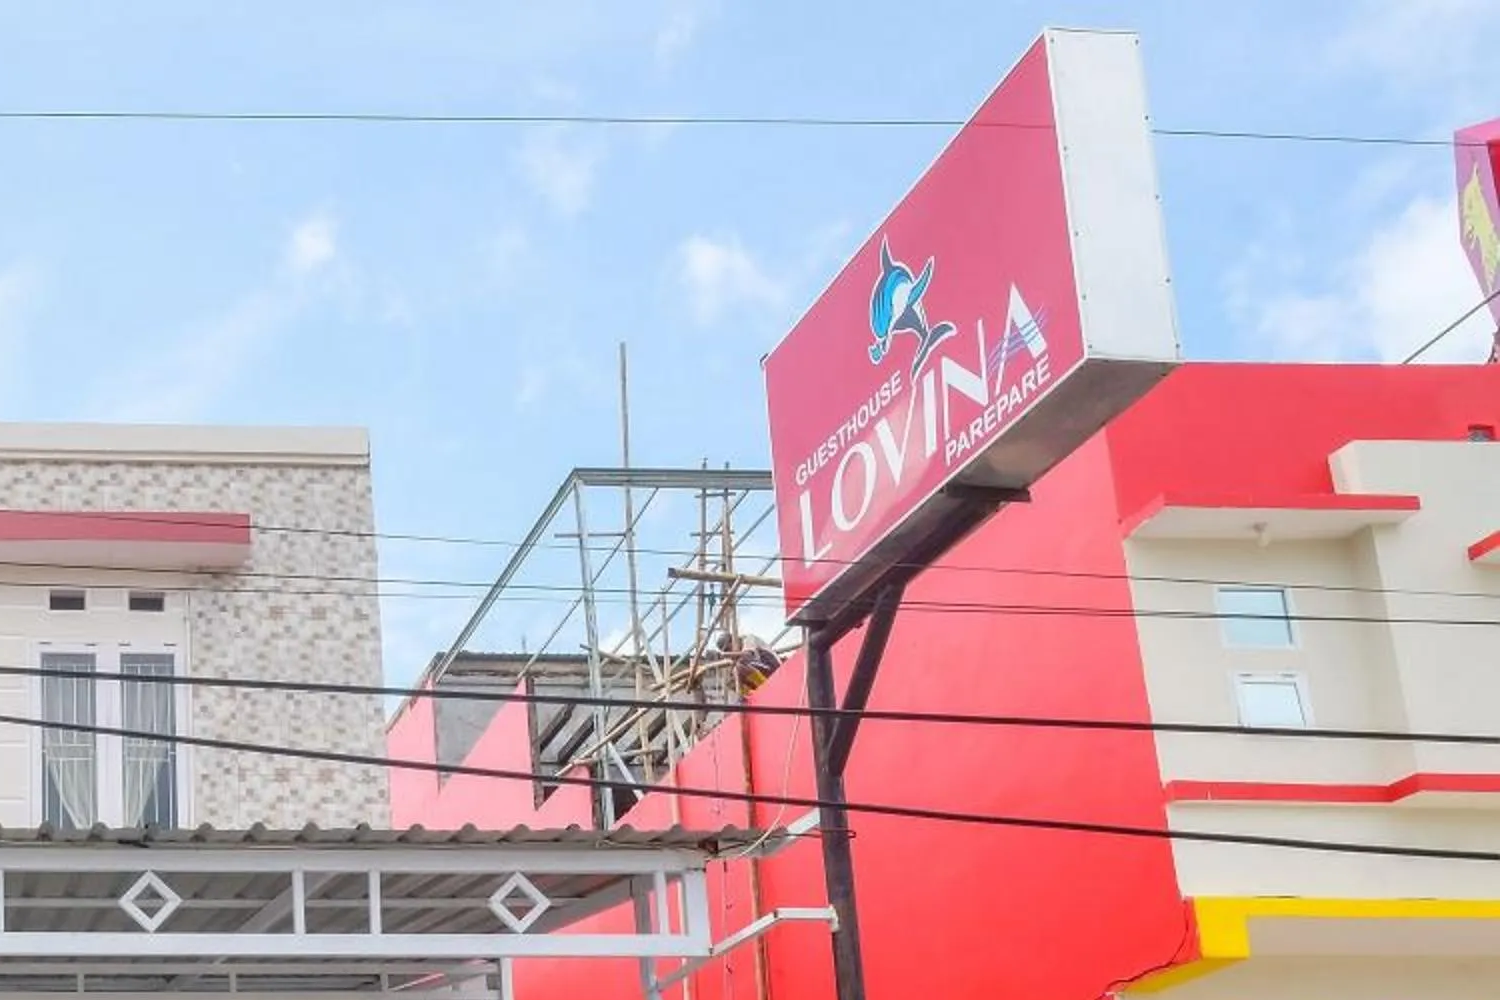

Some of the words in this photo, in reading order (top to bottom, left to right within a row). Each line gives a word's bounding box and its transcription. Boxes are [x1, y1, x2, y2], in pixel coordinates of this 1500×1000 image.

[795, 370, 903, 487] GUESTHOUSE
[798, 281, 1049, 569] LOVINA
[944, 353, 1052, 467] PAREPARE
